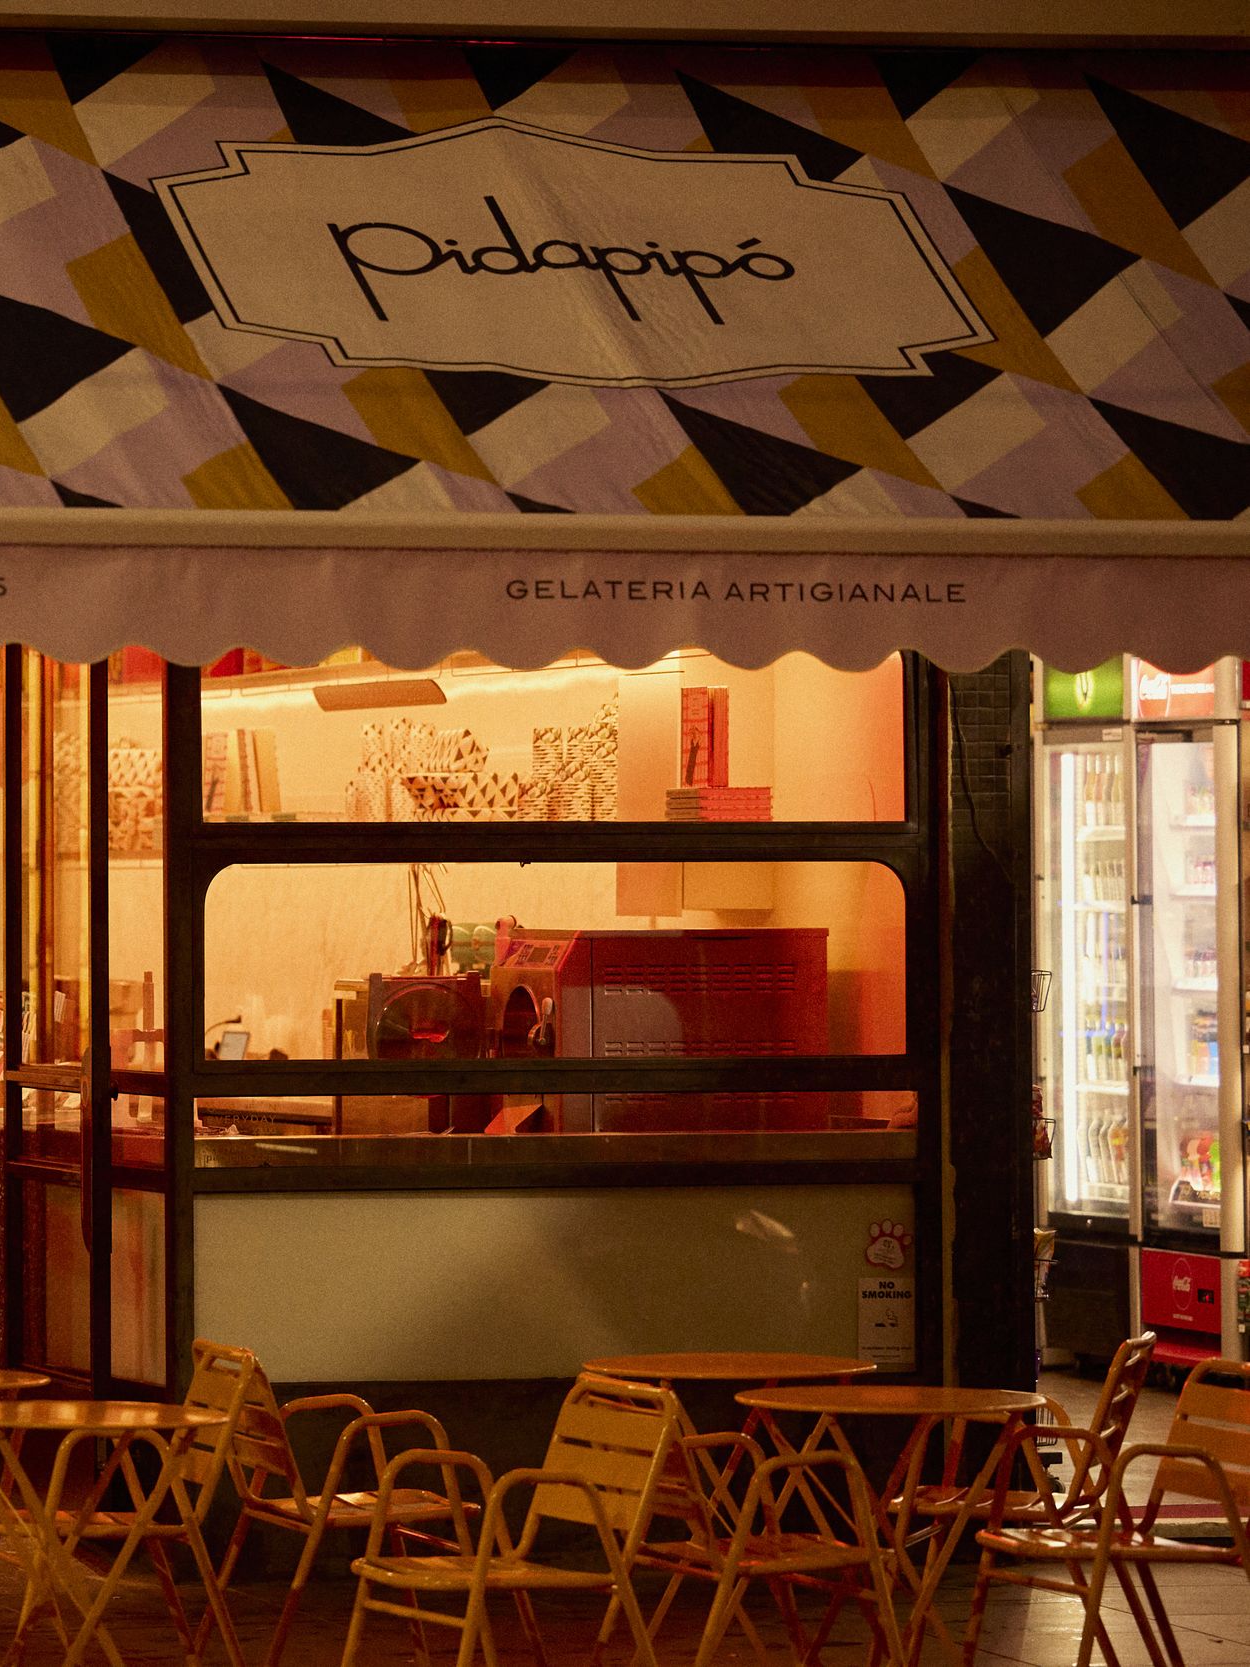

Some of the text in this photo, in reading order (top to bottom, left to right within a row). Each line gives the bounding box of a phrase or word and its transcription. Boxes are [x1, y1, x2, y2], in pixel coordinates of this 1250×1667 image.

[505, 579, 967, 603] GELATERIA ARTIGIANALE
[878, 1281, 895, 1290] NO
[861, 1290, 912, 1299] SMOKING
